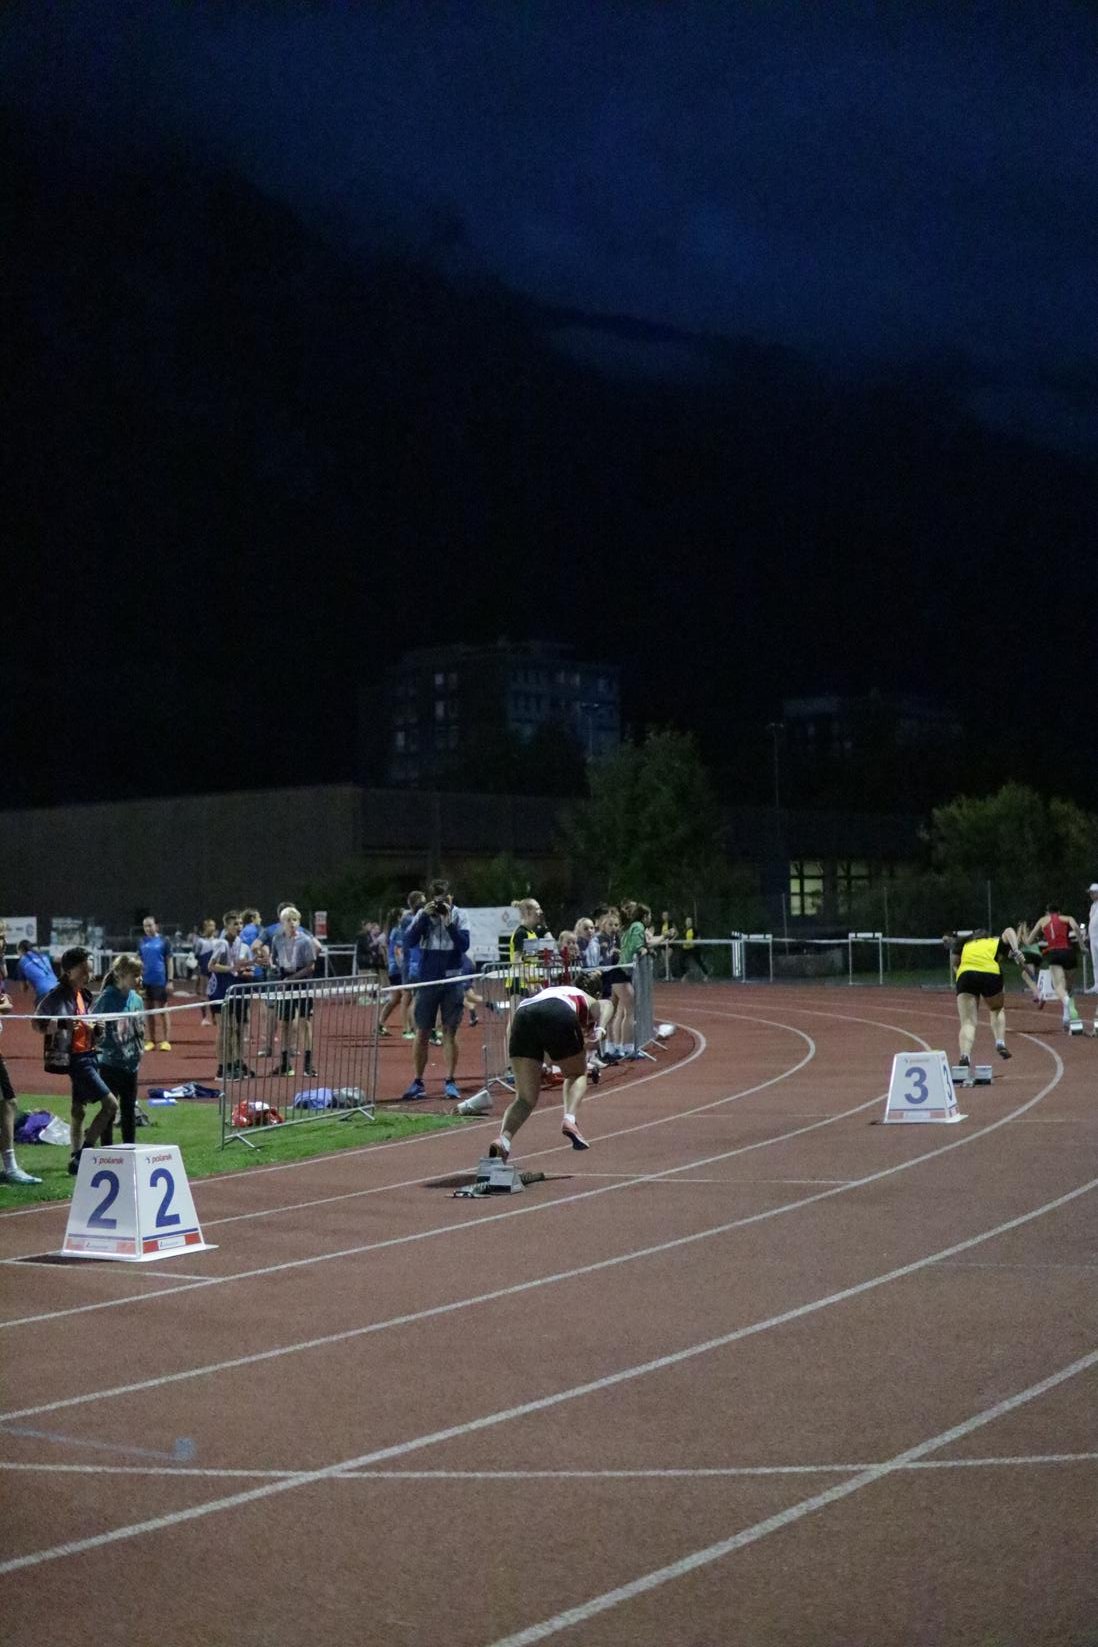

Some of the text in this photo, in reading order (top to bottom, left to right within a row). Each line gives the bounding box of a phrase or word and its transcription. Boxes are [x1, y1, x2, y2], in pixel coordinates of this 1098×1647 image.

[905, 1067, 928, 1104] 3
[86, 1170, 119, 1229] 2
[150, 1168, 180, 1228] 2
